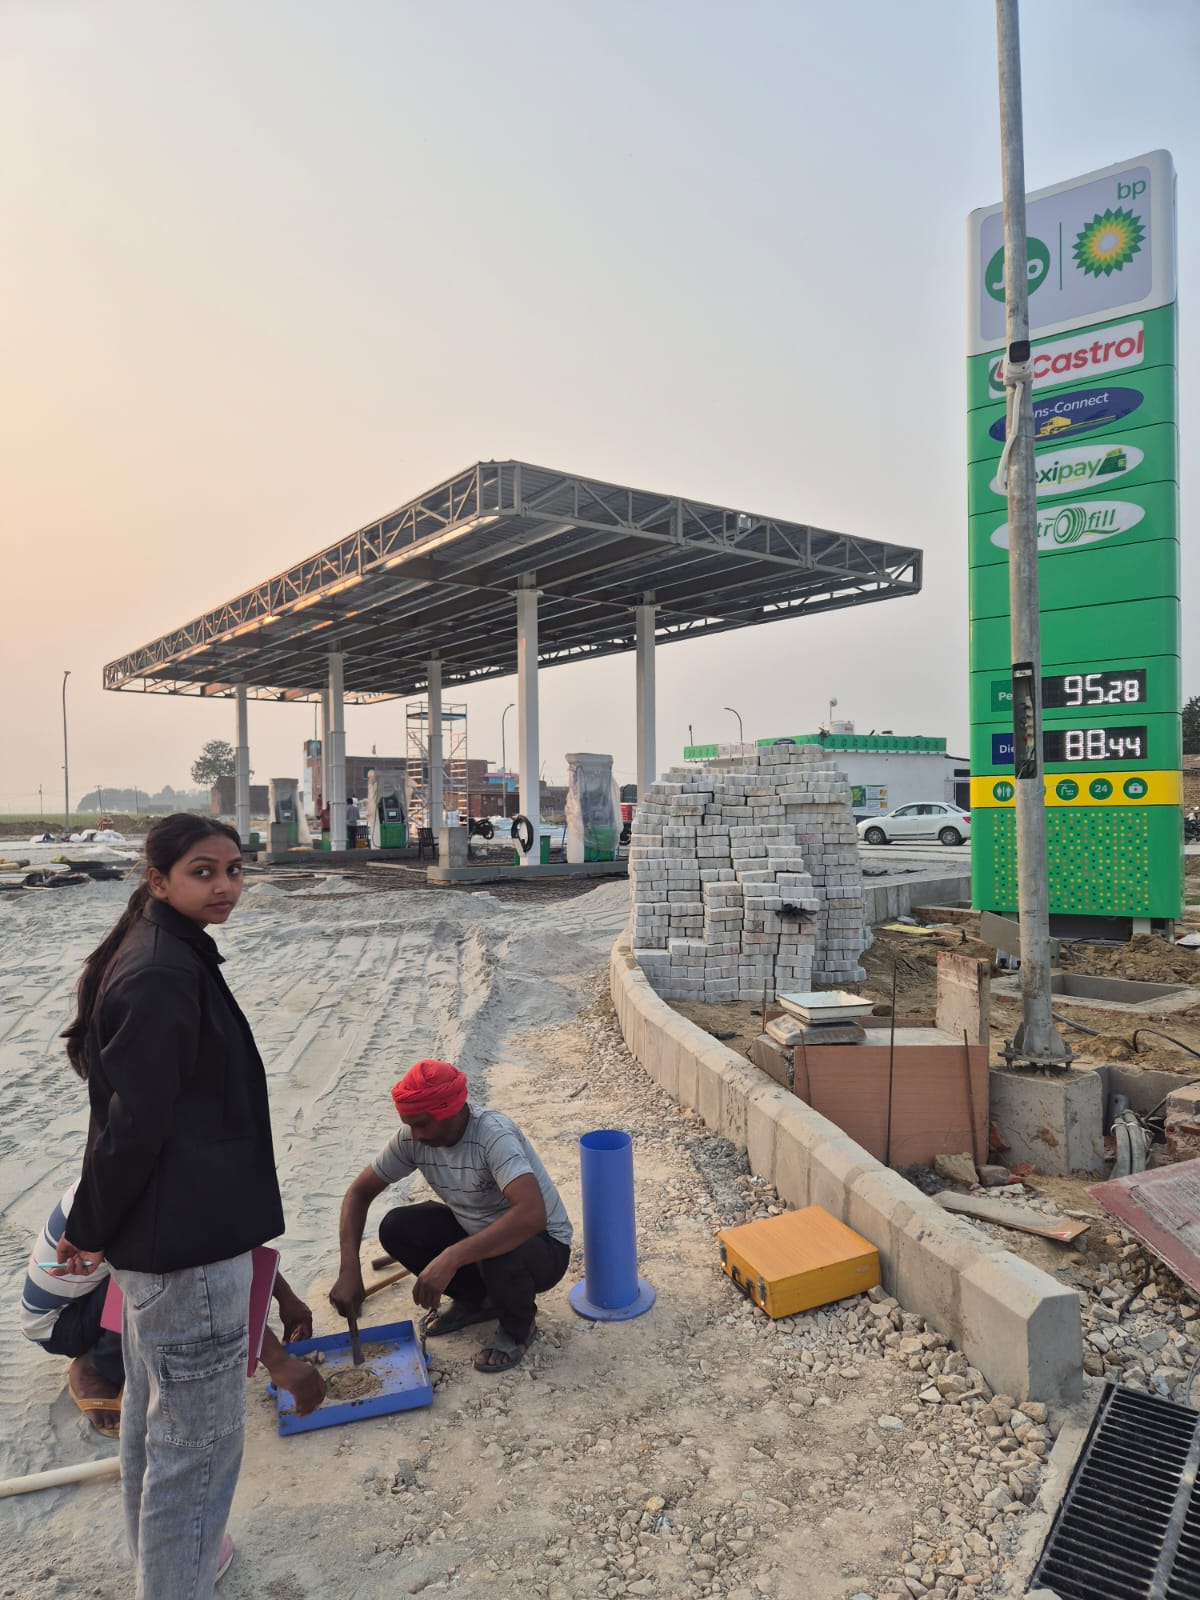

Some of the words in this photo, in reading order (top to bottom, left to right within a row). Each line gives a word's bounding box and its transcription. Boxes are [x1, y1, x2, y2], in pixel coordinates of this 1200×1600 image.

[1117, 179, 1147, 201] bp
[1033, 331, 1144, 379] Castrol
[1034, 391, 1110, 418] ns-Connect
[1064, 673, 1140, 706] 95.28
[1065, 729, 1141, 761] 88.44
[1095, 784, 1108, 793] 24
